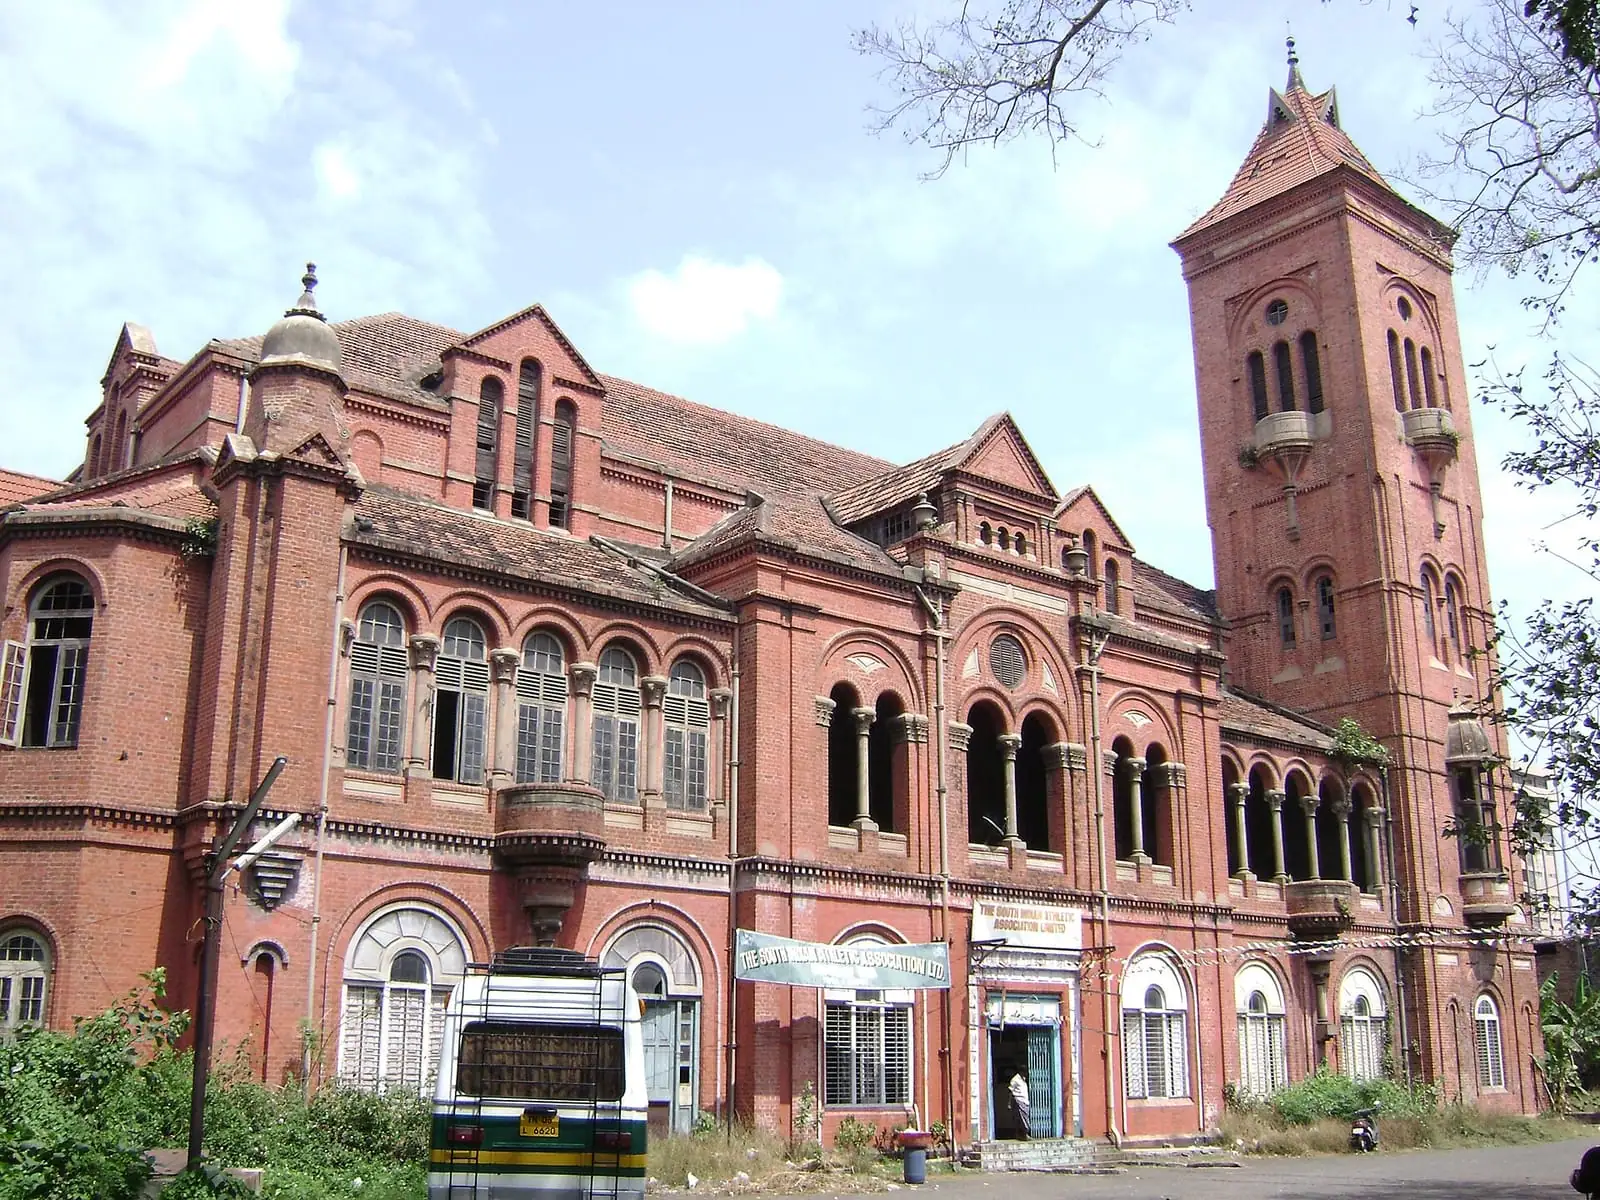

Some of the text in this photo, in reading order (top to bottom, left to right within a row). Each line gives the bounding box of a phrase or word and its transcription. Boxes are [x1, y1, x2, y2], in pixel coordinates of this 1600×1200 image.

[980, 904, 995, 917] THE
[996, 906, 1019, 919] SOUTH
[740, 949, 760, 970] THE
[759, 946, 789, 967] SOUTH
[862, 951, 927, 976] ASSOCIATION
[533, 1127, 556, 1135] 6620
